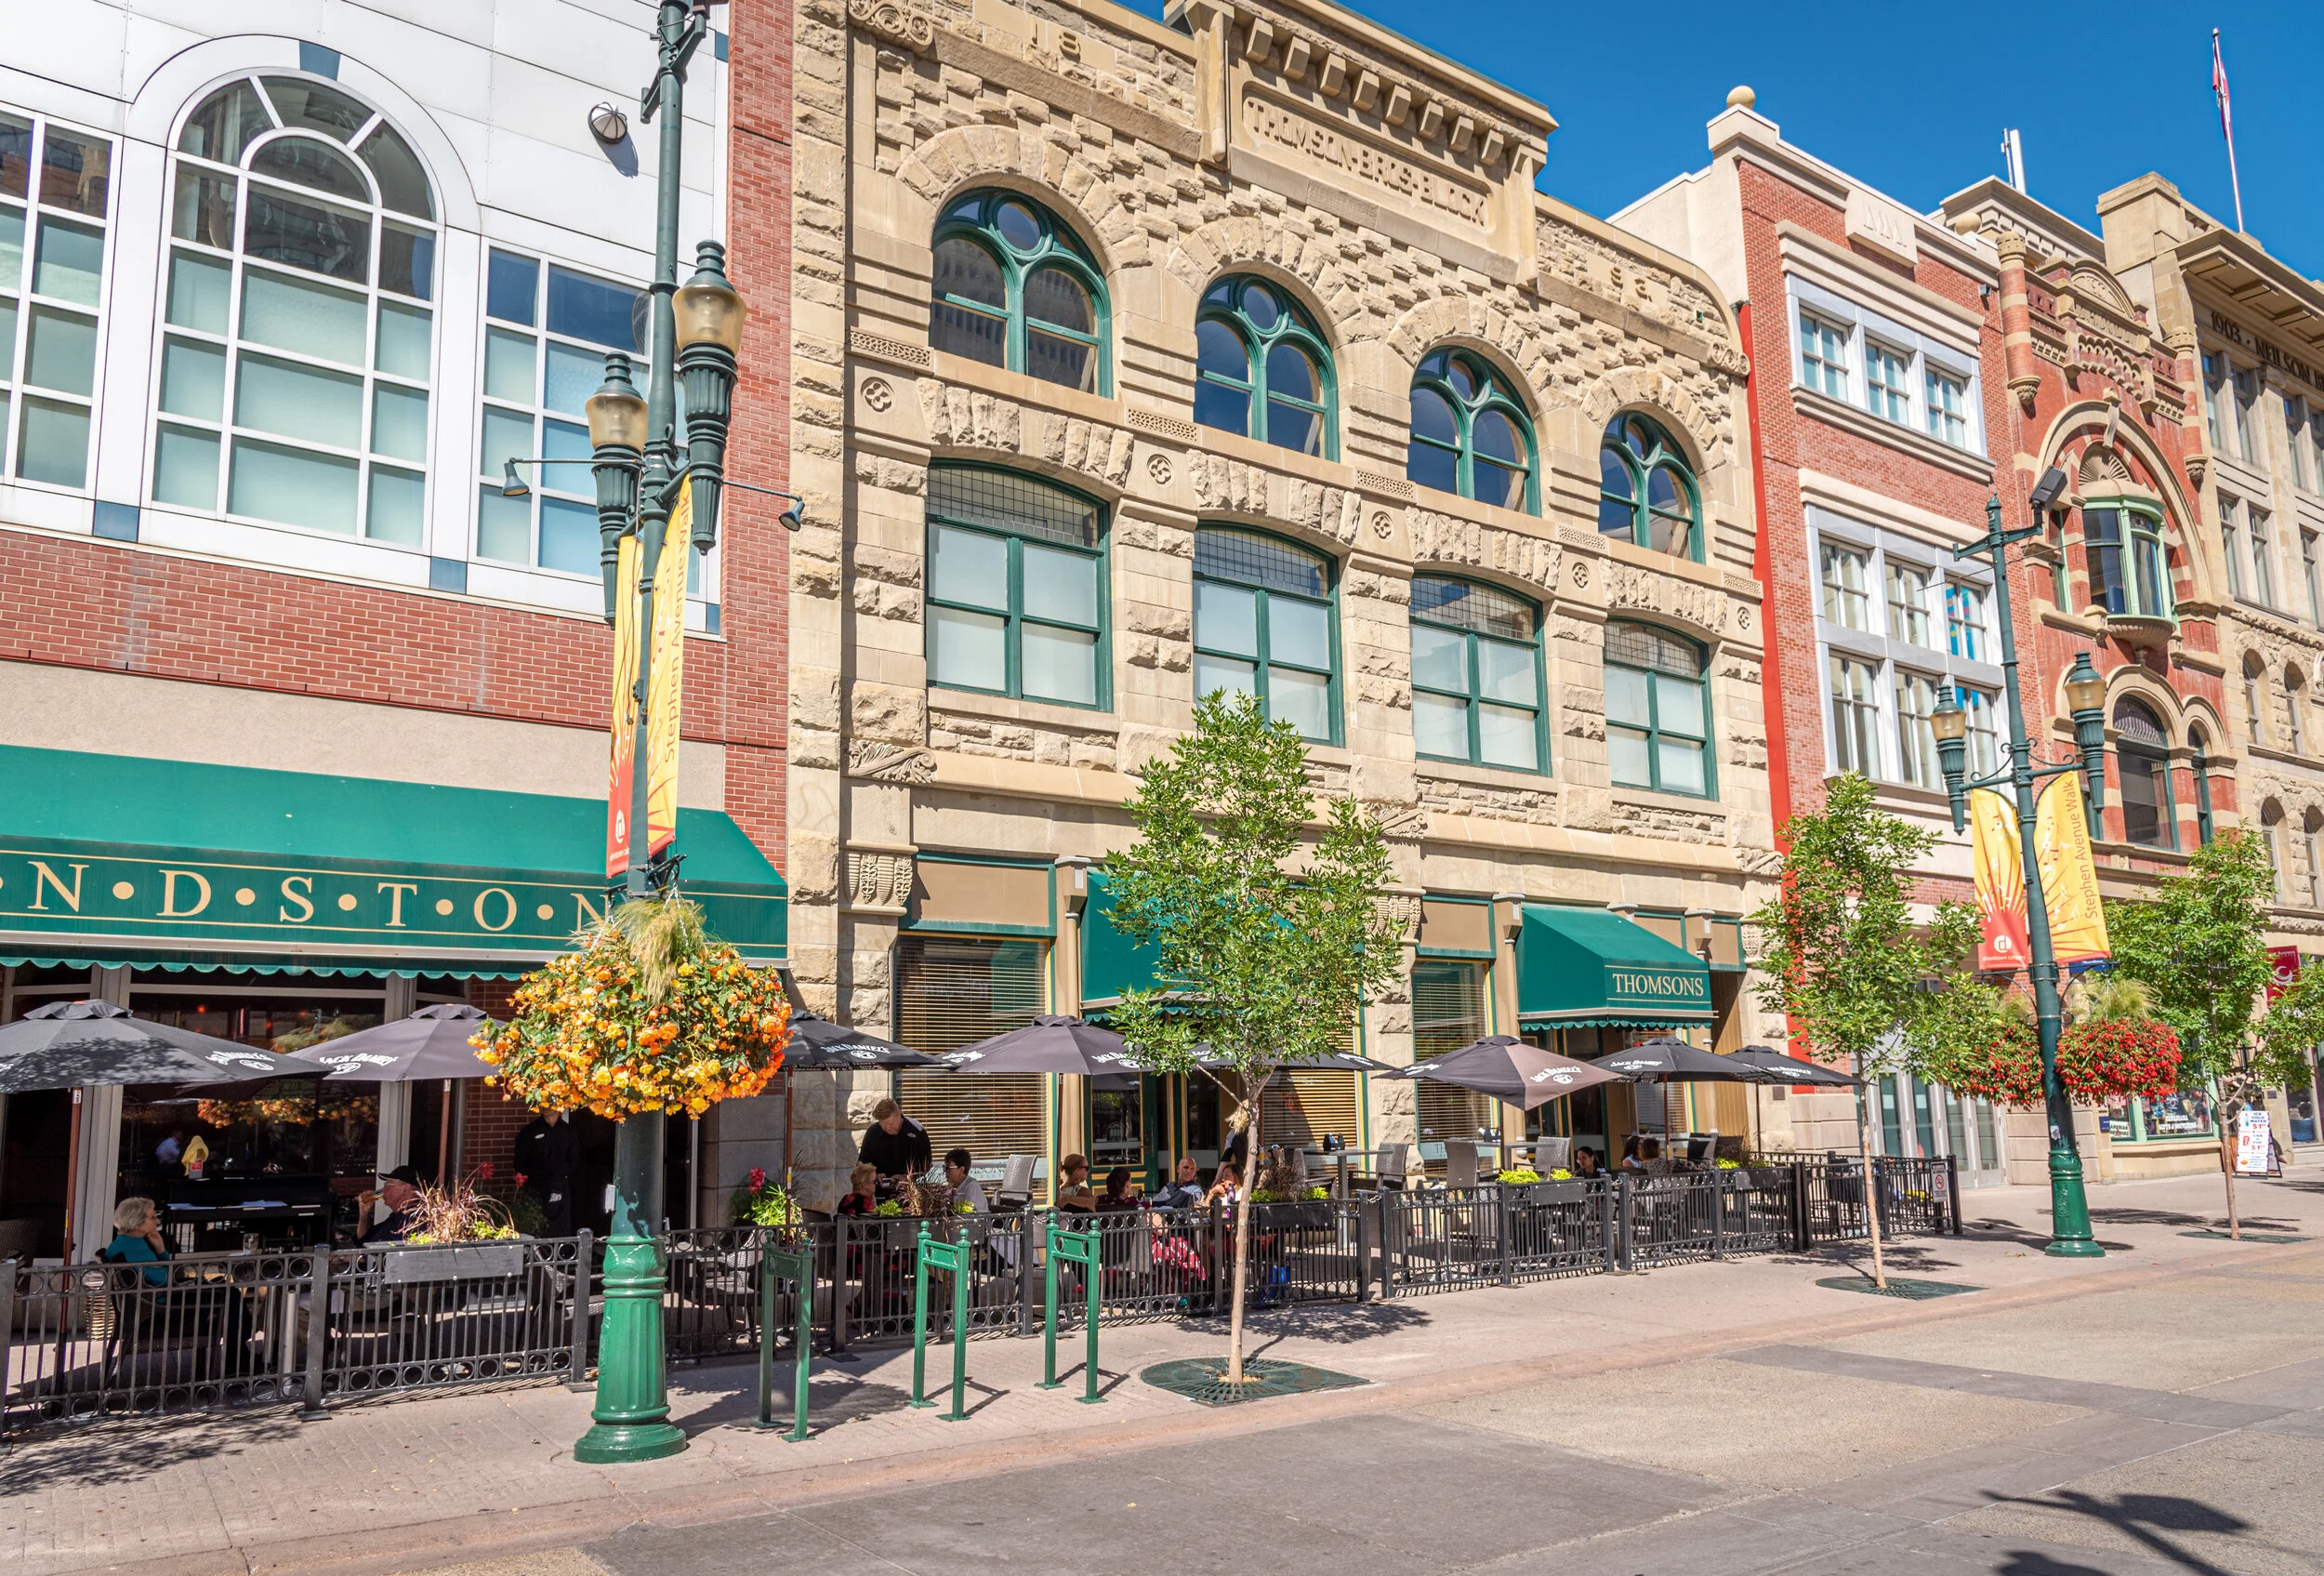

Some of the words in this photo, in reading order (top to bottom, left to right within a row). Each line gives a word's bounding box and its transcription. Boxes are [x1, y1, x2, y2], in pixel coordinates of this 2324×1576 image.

[2210, 311, 2242, 344] 1903
[2254, 335, 2312, 385] NEILSON
[680, 490, 691, 550] Walk
[671, 556, 685, 648] Avenue
[664, 655, 680, 764] Stephen
[2062, 779, 2077, 814] Walk
[2067, 814, 2088, 861] Avenue
[2080, 861, 2098, 920] Stephen
[1612, 973, 1704, 997] THOMSONS
